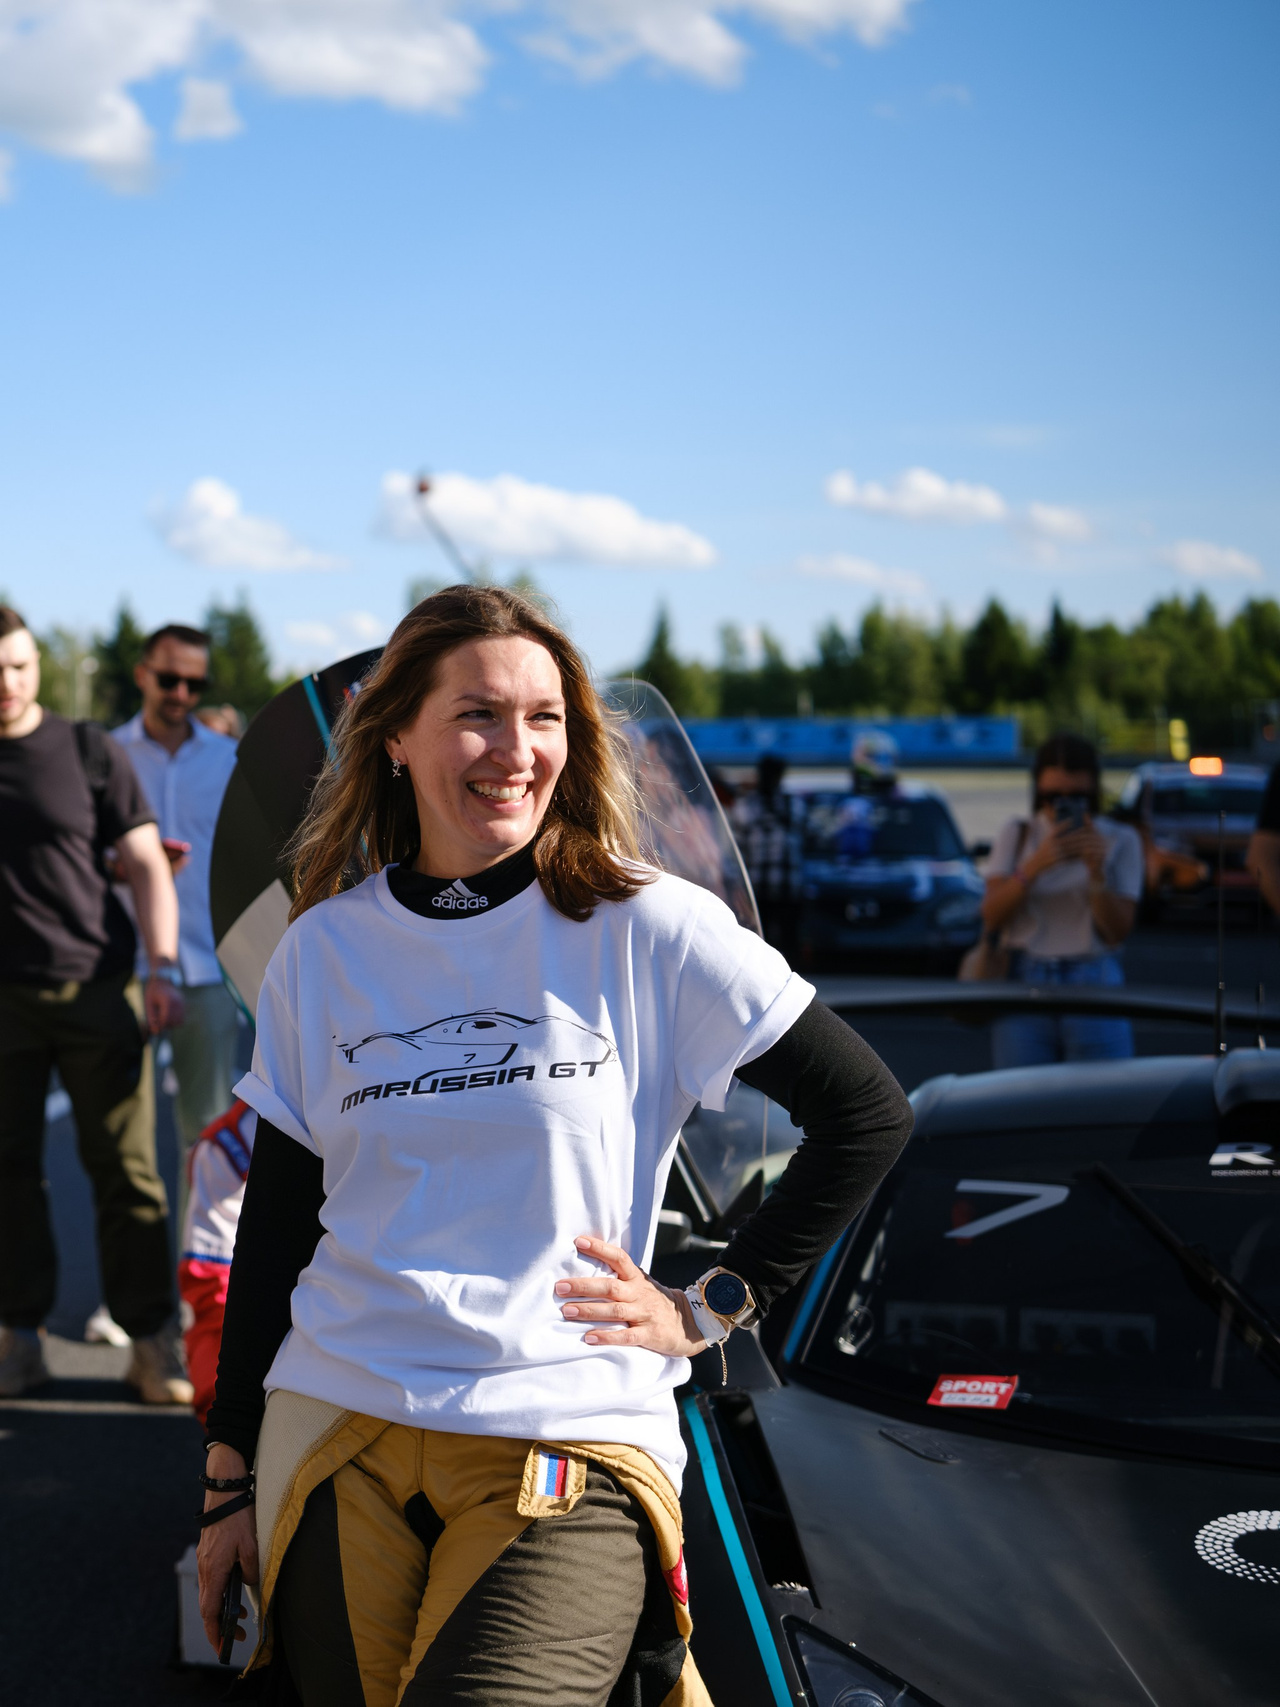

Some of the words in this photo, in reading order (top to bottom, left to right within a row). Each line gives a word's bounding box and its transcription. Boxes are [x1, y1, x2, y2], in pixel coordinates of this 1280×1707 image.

[431, 893, 489, 910] adidas
[463, 1053, 477, 1064] 7
[340, 1065, 535, 1114] MARUSSIA
[548, 1060, 607, 1079] GT
[942, 1178, 1071, 1239] 7
[938, 1379, 1013, 1395] SPORT
